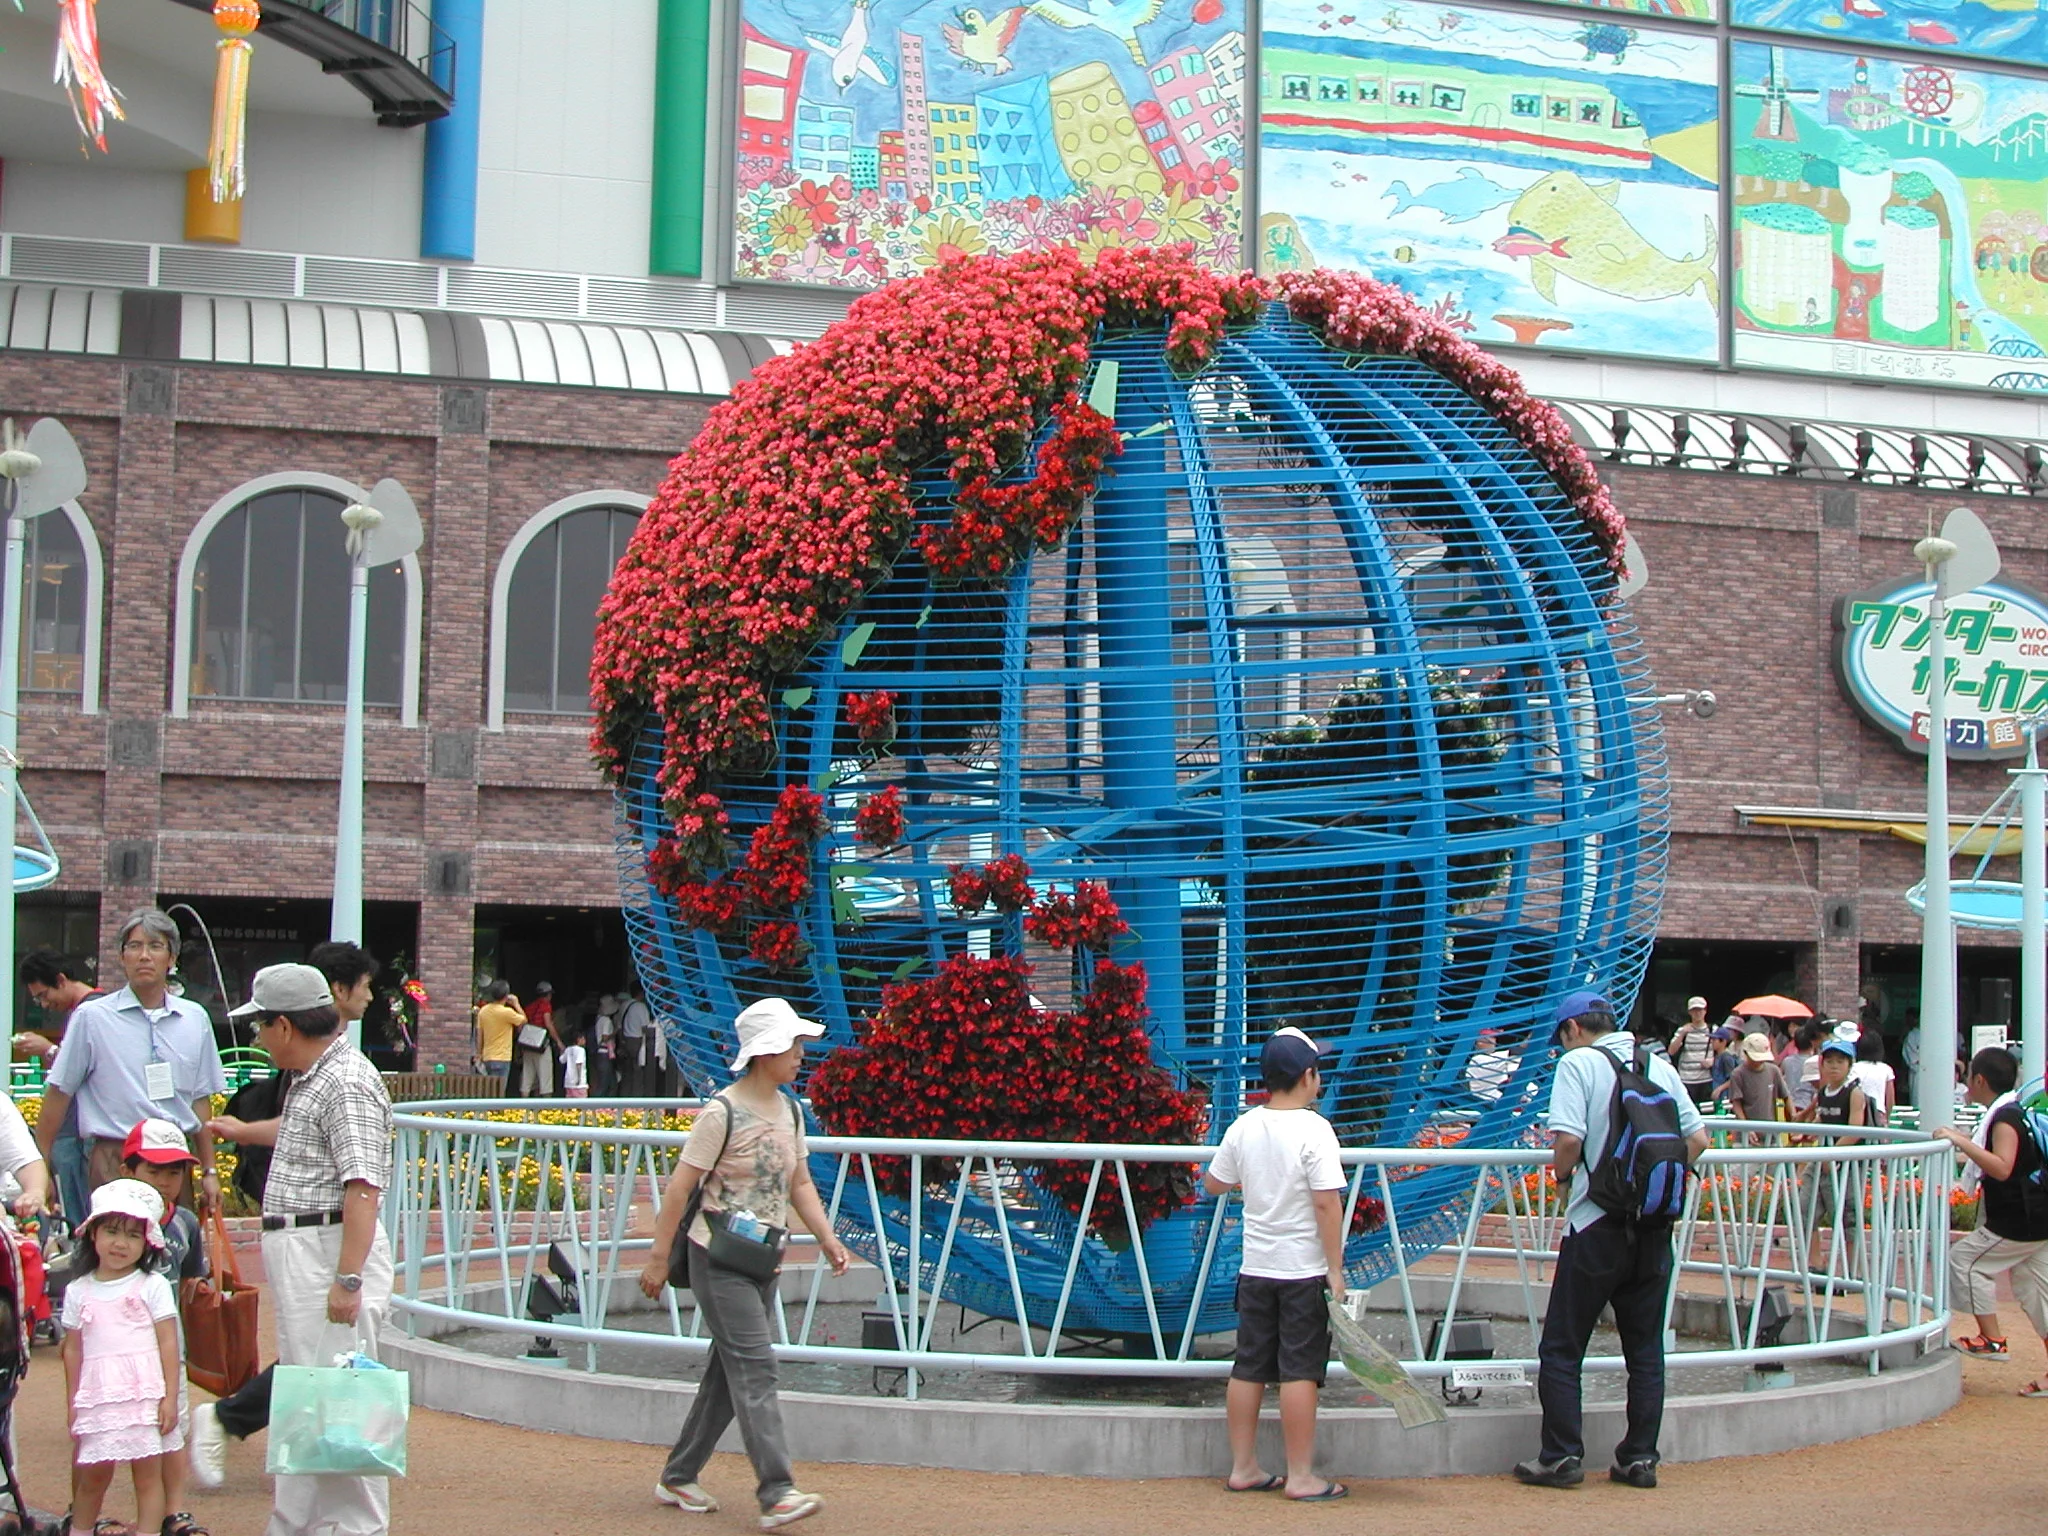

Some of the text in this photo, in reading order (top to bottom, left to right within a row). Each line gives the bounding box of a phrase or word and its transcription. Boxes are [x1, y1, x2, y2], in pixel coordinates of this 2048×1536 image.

[1850, 601, 2017, 654] ワンダー
[2019, 643, 2048, 657] CIRC
[1458, 1371, 1521, 1382] 入らないでください
